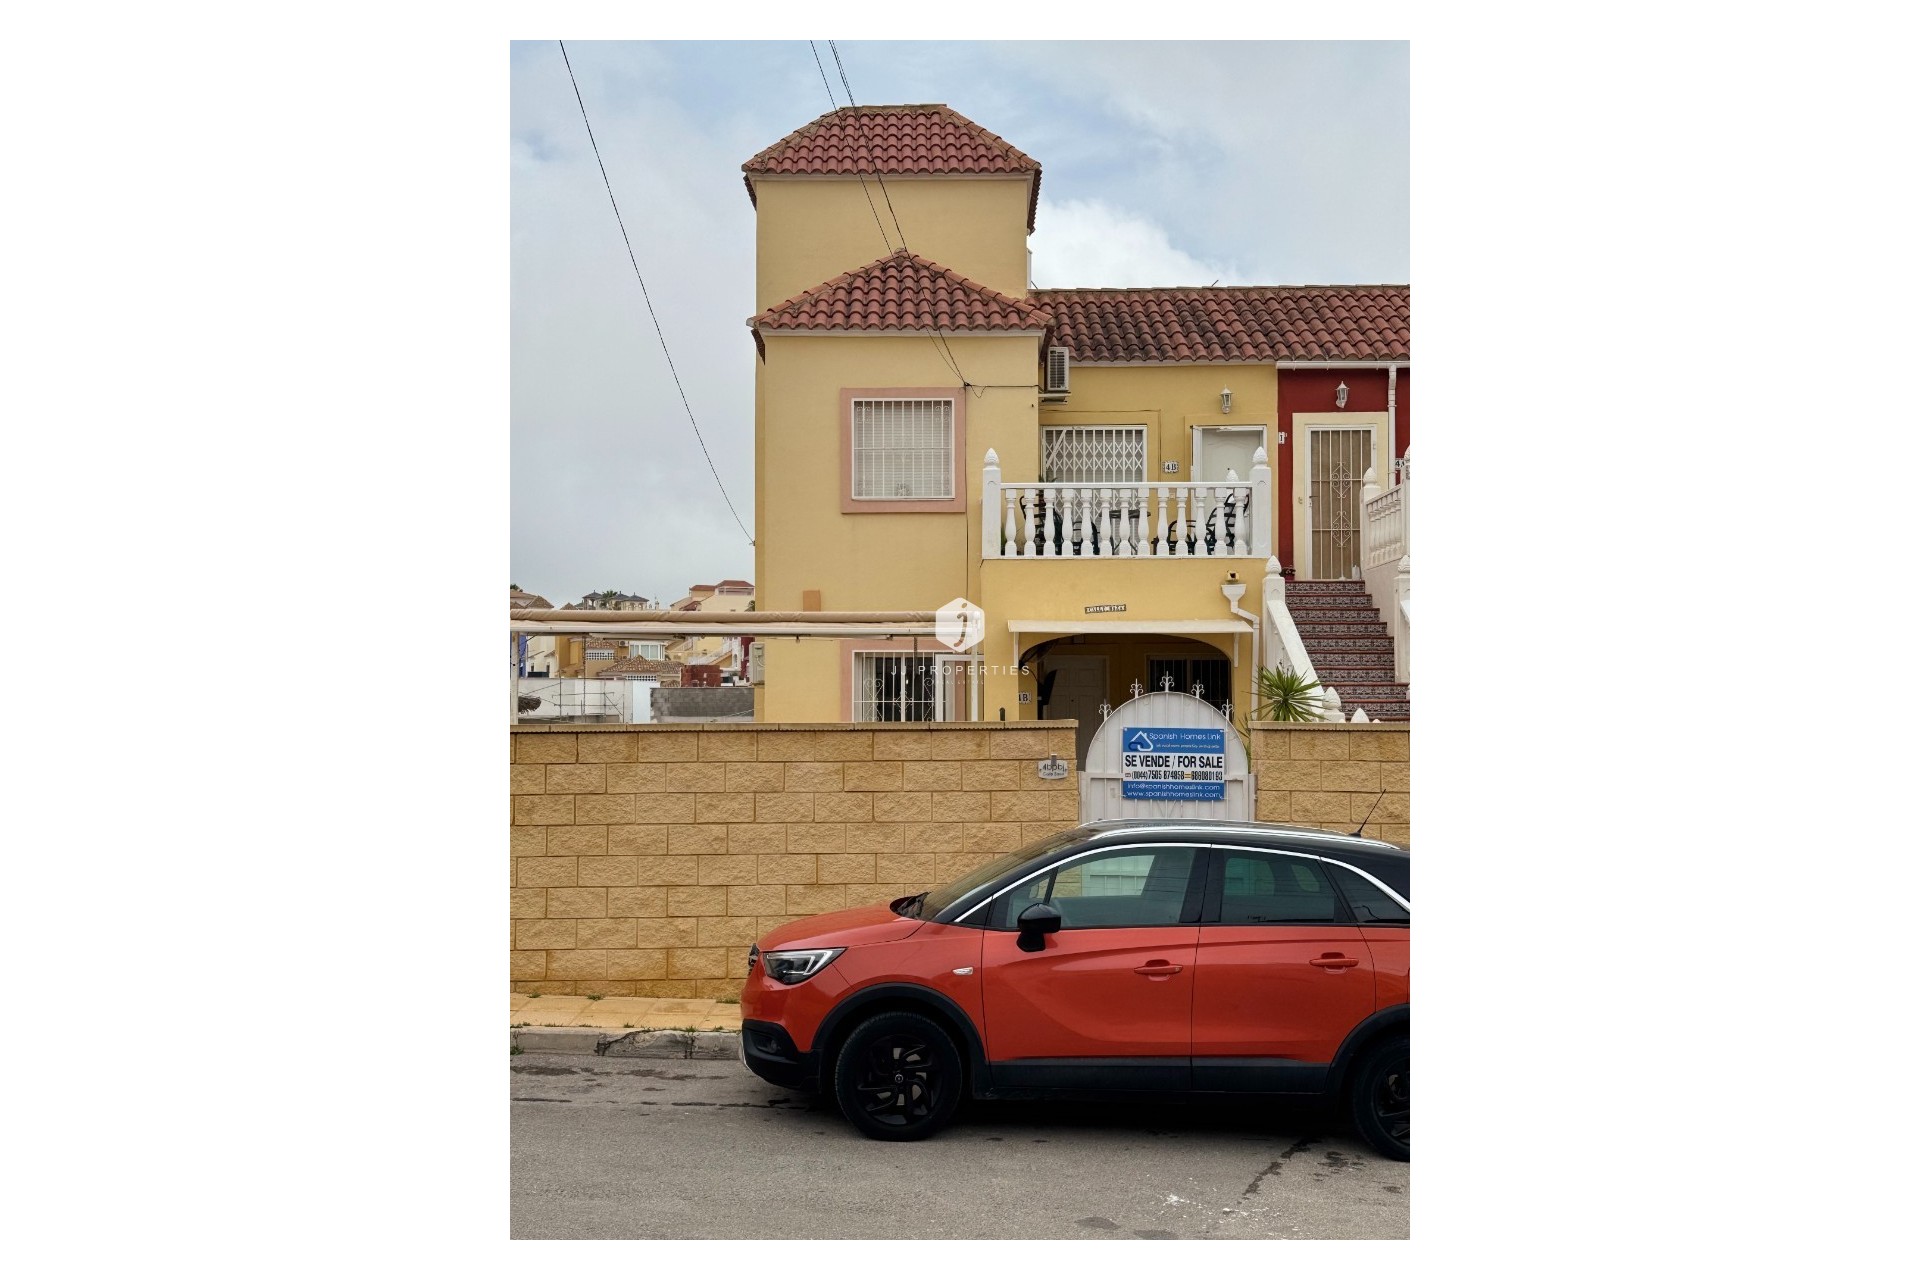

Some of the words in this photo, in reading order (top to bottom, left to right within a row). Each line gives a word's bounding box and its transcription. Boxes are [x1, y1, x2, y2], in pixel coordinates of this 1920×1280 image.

[1149, 732, 1178, 740] Spanish
[1125, 755, 1137, 767] SE
[1139, 755, 1170, 768] VENDE
[1177, 755, 1196, 768] FOR
[1198, 756, 1223, 768] SALE
[1127, 790, 1220, 798] www.spanishhomeslink.com
